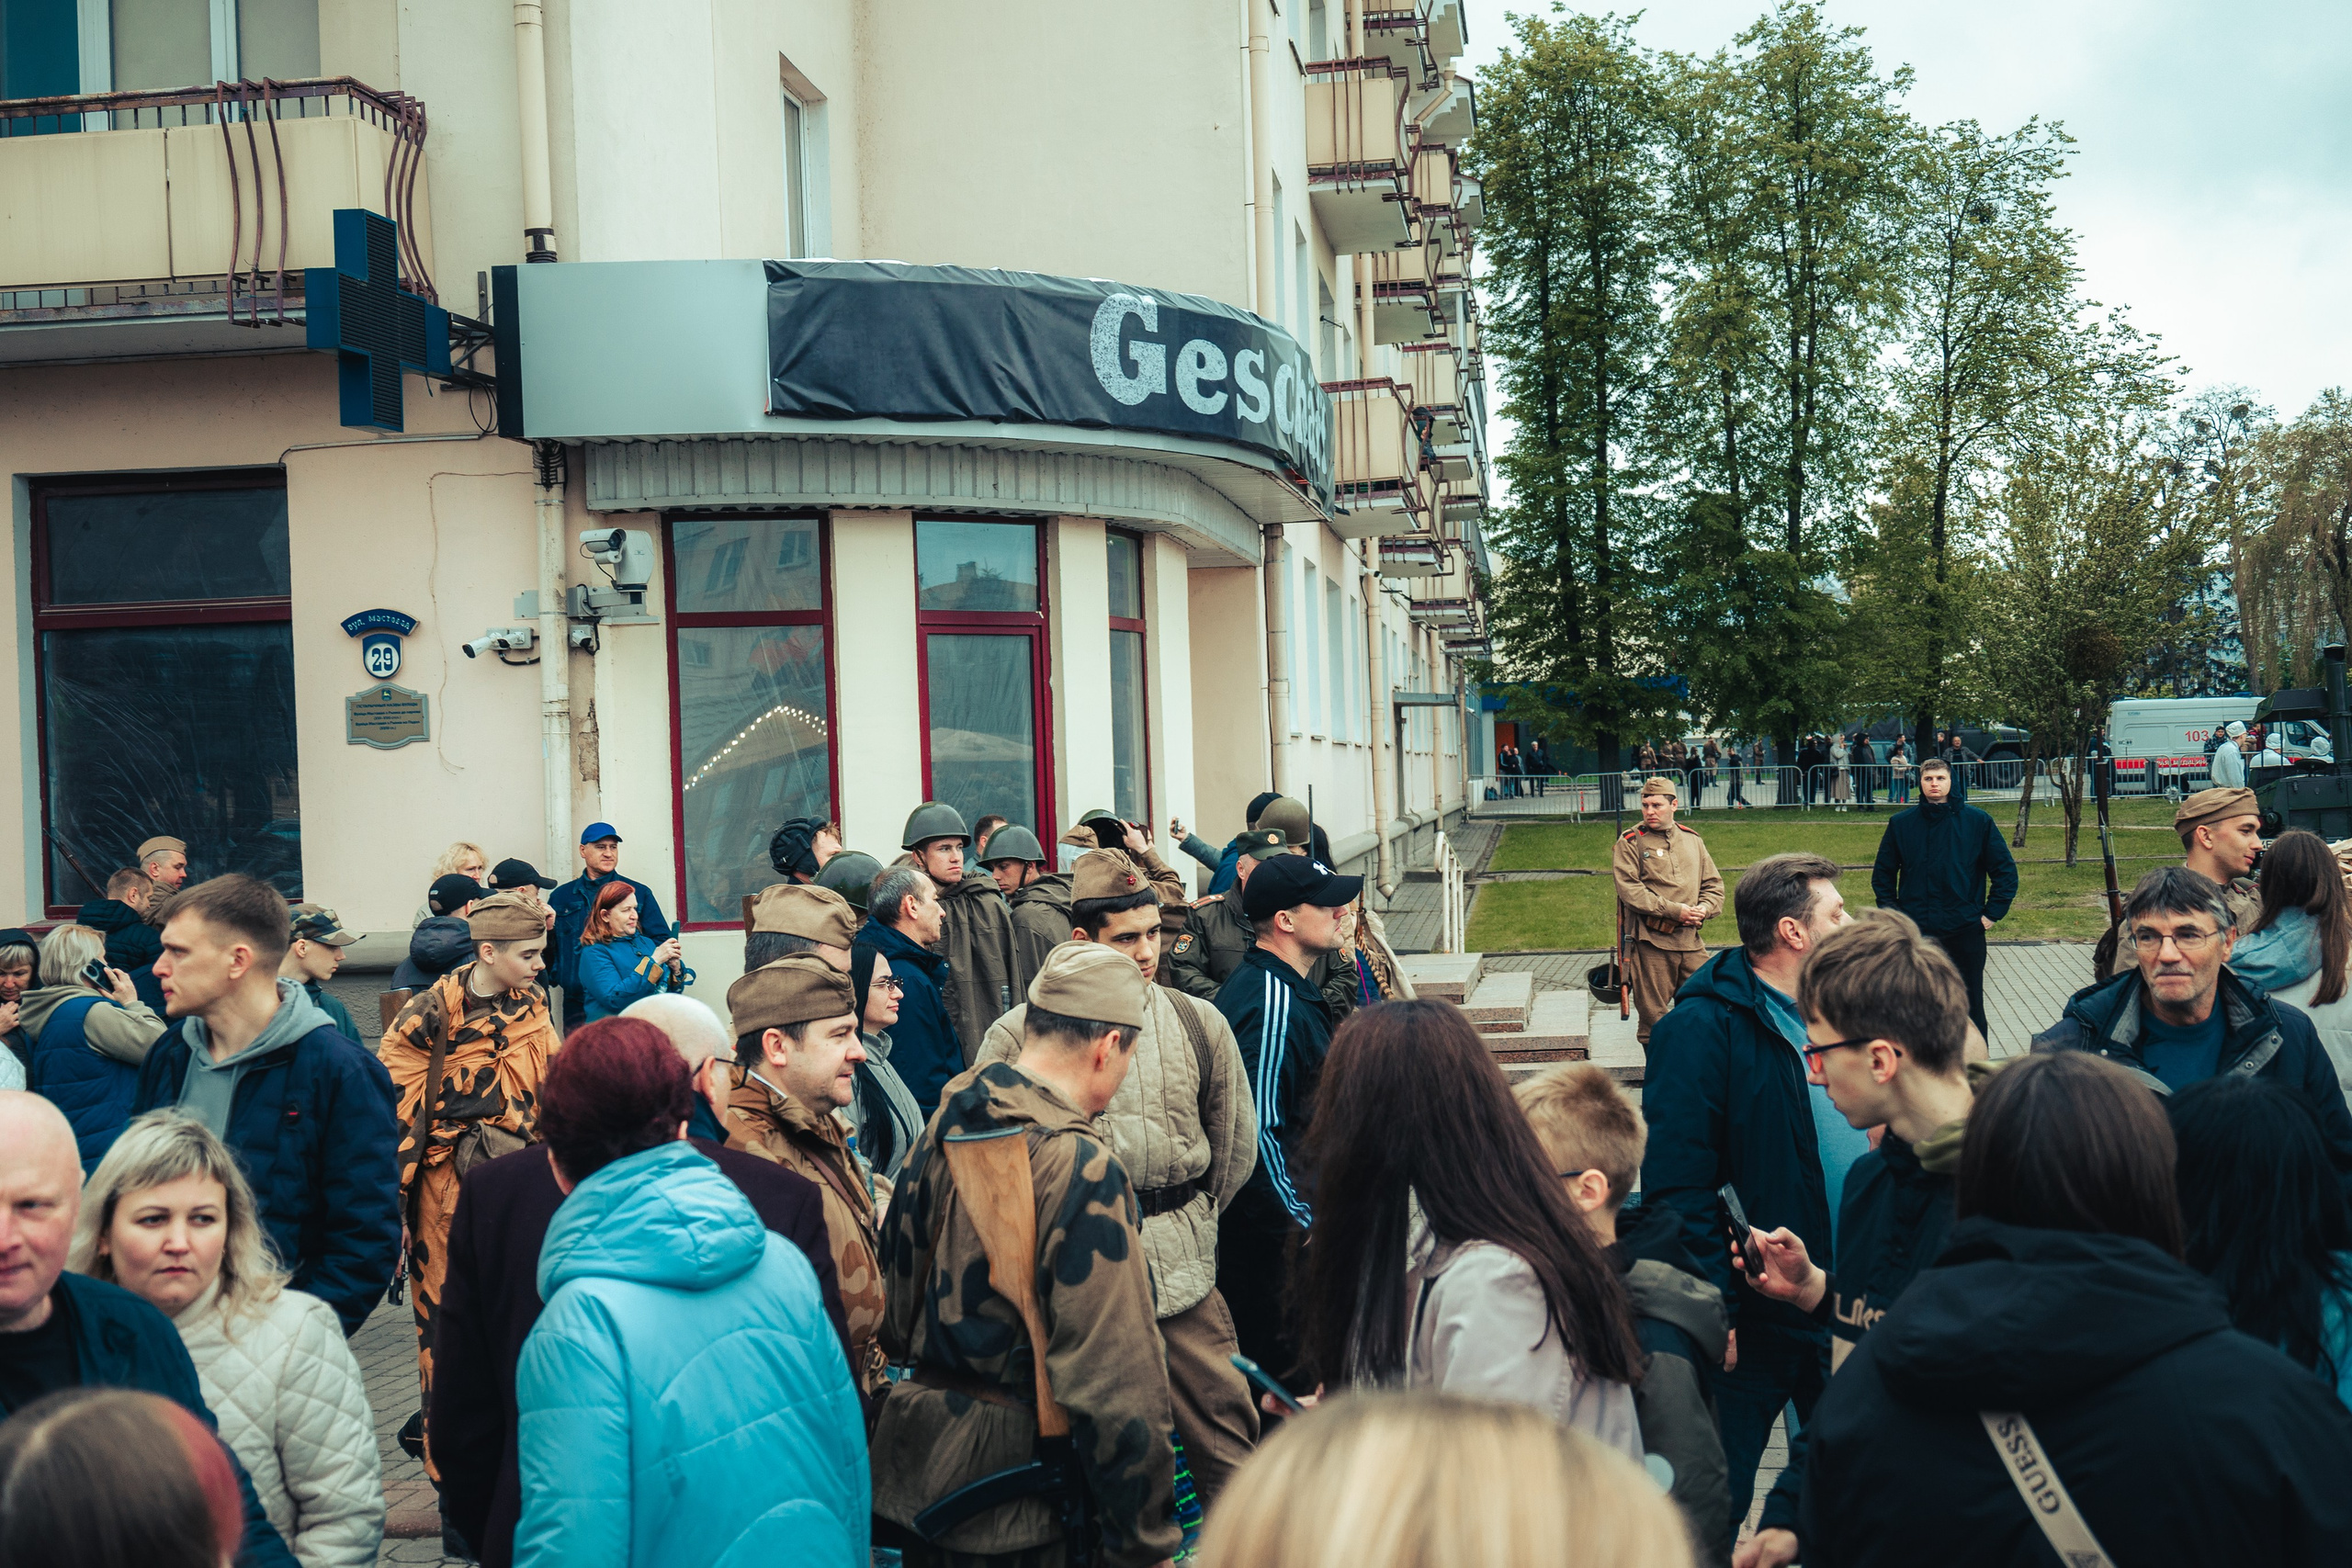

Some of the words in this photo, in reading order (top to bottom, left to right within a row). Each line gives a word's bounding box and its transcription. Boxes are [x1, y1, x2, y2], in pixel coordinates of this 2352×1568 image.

[371, 647, 394, 671] 29
[2185, 729, 2210, 742] 103
[1997, 1416, 2060, 1515] GUESS
